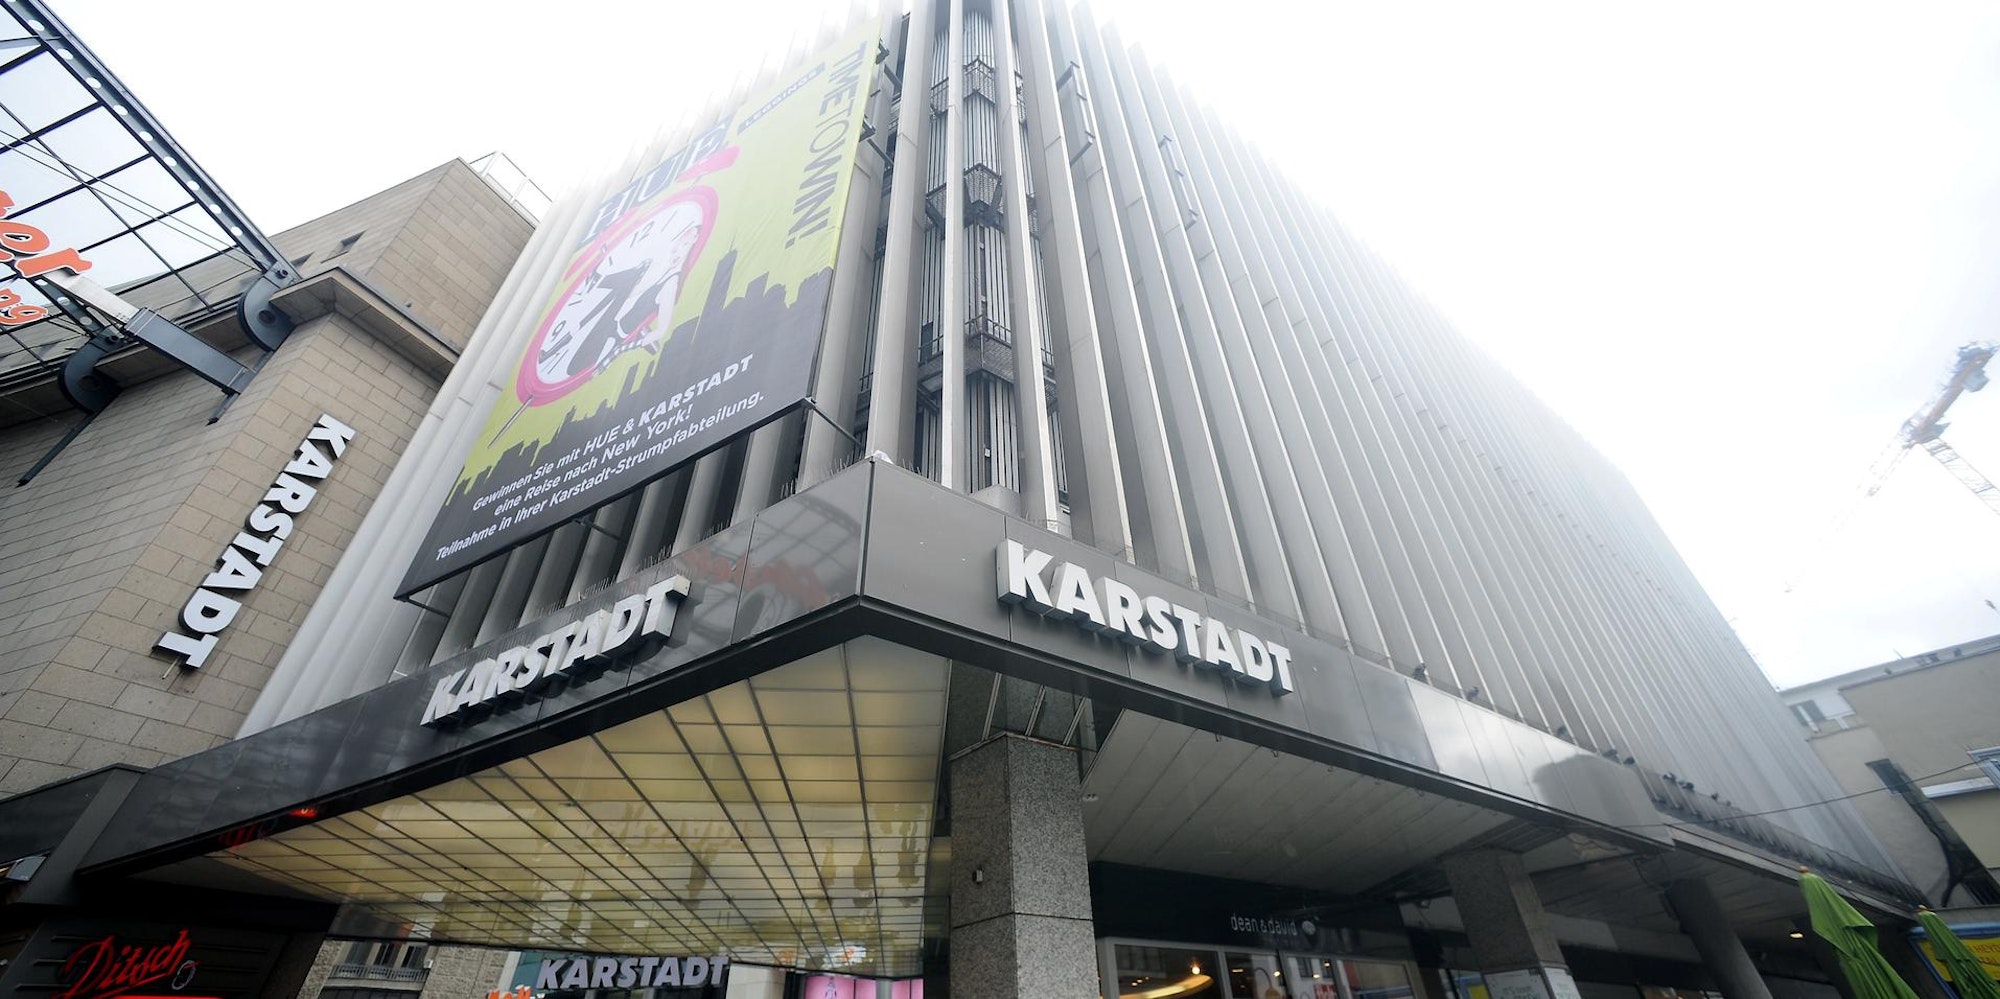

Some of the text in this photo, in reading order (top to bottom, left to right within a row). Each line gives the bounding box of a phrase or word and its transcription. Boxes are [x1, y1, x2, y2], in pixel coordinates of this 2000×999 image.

[435, 391, 766, 561] Teilnahme in Ihrer Karstadt-Strumpfabteilung.
[472, 354, 754, 512] Gewinnen Sie mit HUE & KARSTADT
[493, 403, 694, 516] eine Reise nach New York!
[152, 413, 356, 670] KARSTADT
[1000, 538, 1294, 694] KARSTADT
[420, 574, 691, 727] KARSTADT
[54, 928, 192, 998] Ditsch
[535, 955, 730, 990] KARSTADT
